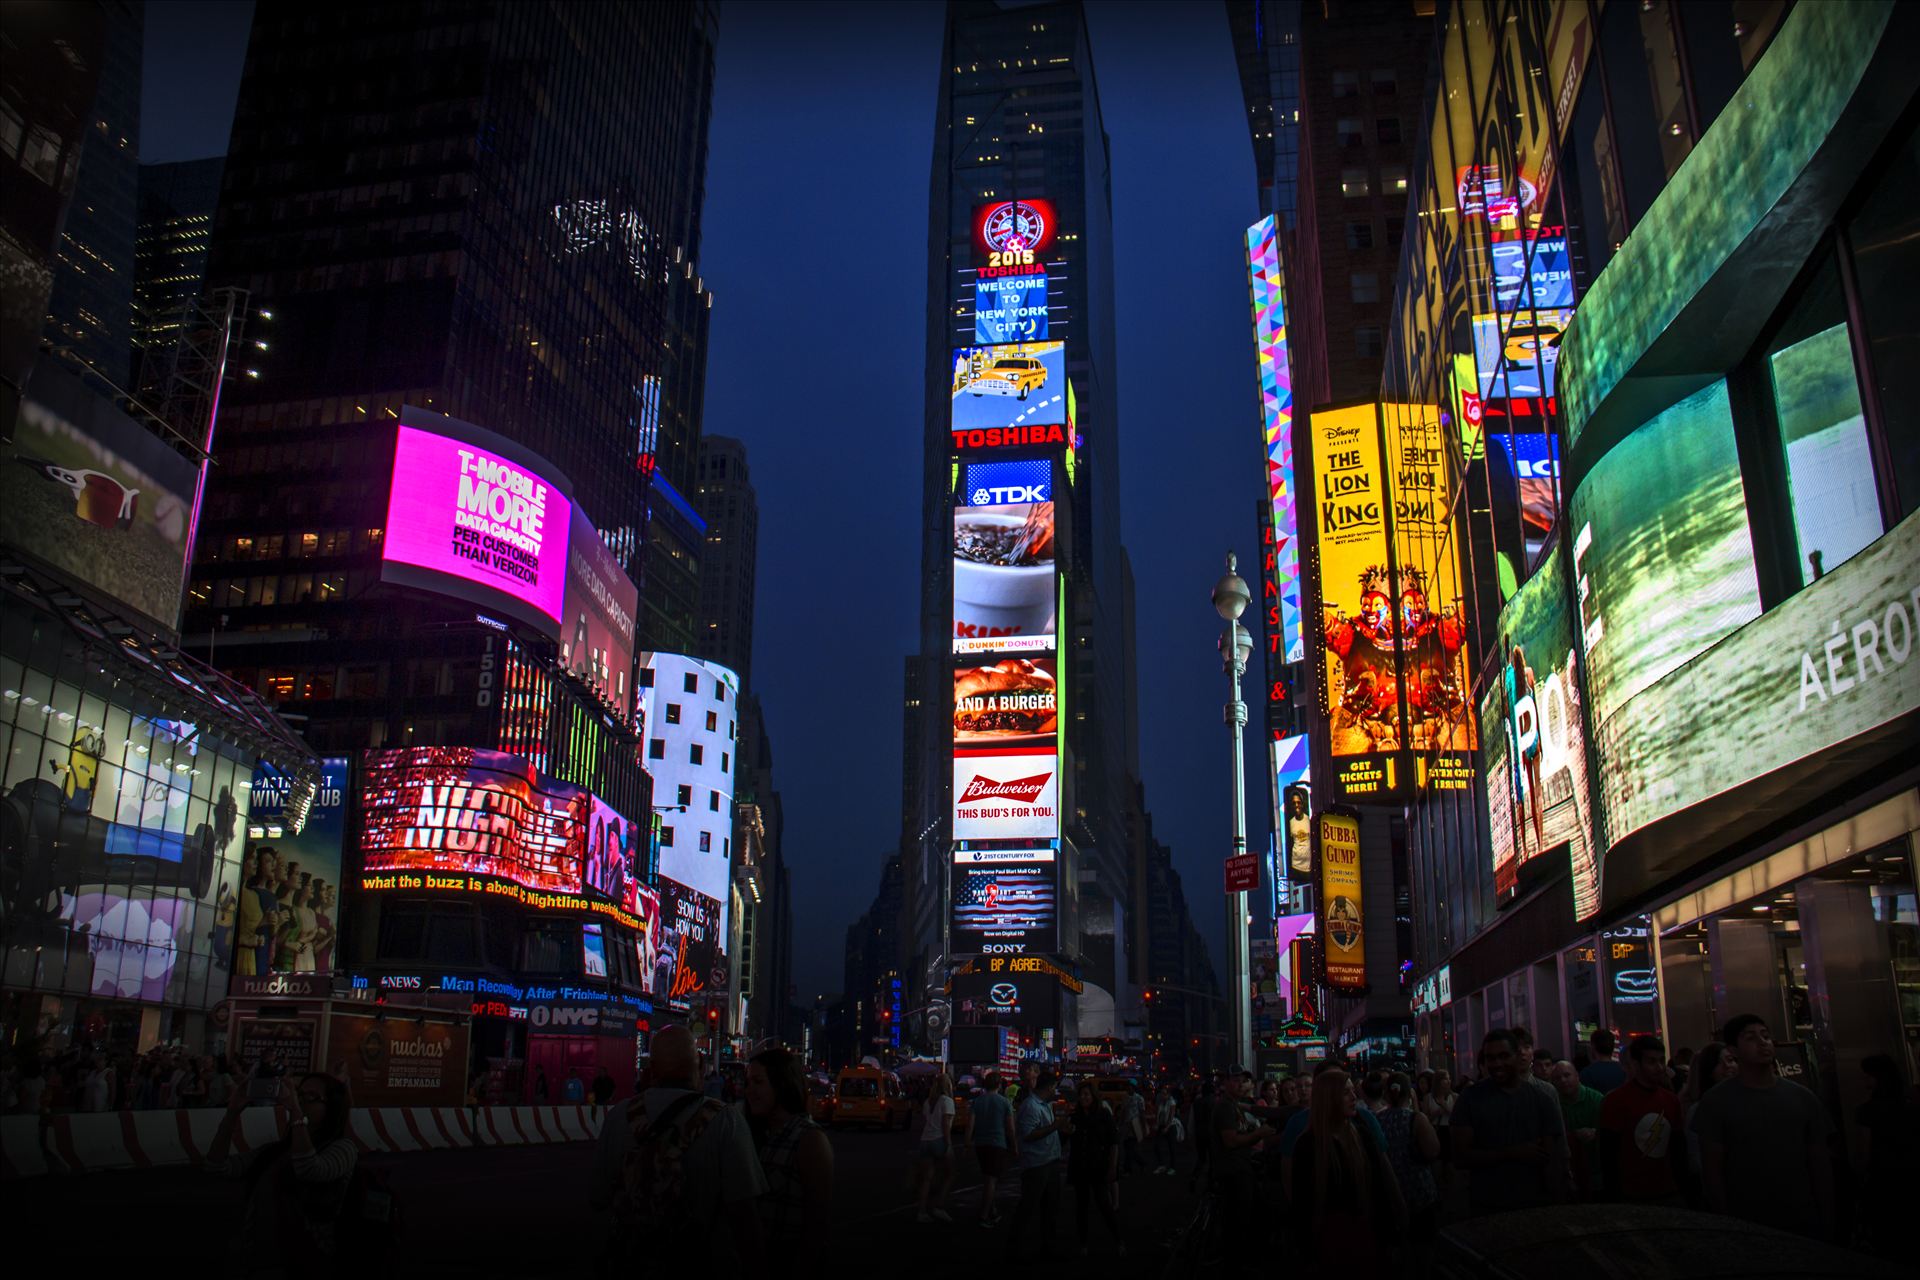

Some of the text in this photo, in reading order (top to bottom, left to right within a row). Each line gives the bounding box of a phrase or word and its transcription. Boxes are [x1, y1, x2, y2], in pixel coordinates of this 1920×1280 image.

[1555, 56, 1577, 132] STREET
[989, 250, 1034, 267] 2015
[977, 263, 1046, 278] TOSHIBA
[978, 278, 1045, 292] WELCOME
[1003, 294, 1020, 304] TO
[976, 305, 1048, 320] NEW YORK
[996, 322, 1027, 333] CITY
[952, 424, 1064, 448] TOSHIBA
[1322, 427, 1360, 439] Disney
[1327, 450, 1361, 468] THE
[458, 449, 547, 509] T-MOBILE
[1323, 473, 1369, 500] LION
[989, 485, 1045, 502] TDK
[456, 475, 545, 542] MORE
[1322, 501, 1379, 533] KING
[455, 510, 541, 556] DATA CAPACITY
[453, 526, 539, 571] PER CUSTOMER
[451, 541, 490, 565] THAN
[492, 554, 538, 586] VERIZON
[571, 545, 634, 641] MORE DATA CAPACITY
[1265, 527, 1281, 654] ERNST
[968, 639, 1045, 650] DUNKIN' DONUTS
[476, 635, 495, 707] 1500
[956, 694, 1055, 712] AND A BURGER
[1351, 761, 1371, 770] GET
[1340, 770, 1382, 783] TICKETS
[966, 781, 1045, 797] Budweiser
[1347, 782, 1377, 793] HERE!
[957, 807, 1054, 819] THIS BUD'S FOR YOU.
[1322, 822, 1358, 844] BUBBA
[1326, 844, 1356, 864] GUMP
[1230, 866, 1254, 877] ANYTIME
[1327, 877, 1359, 885] COMPANY
[363, 876, 396, 889] what
[399, 875, 421, 888] the
[426, 875, 464, 890] buzz
[468, 877, 482, 891] is
[527, 892, 588, 909] Nightline
[677, 899, 704, 923] SHOW US
[675, 918, 704, 942] HOW YOU
[982, 944, 1026, 953] SONY
[990, 958, 1004, 971] BP
[1328, 966, 1364, 976] RESTAURANT
[244, 976, 312, 994] nuchas
[388, 976, 421, 988] NEWS
[442, 976, 474, 991] Man
[526, 986, 558, 999] After
[552, 1007, 599, 1026] NYC
[390, 1036, 444, 1057] nuchas
[387, 1077, 441, 1088] EMPANADAS
